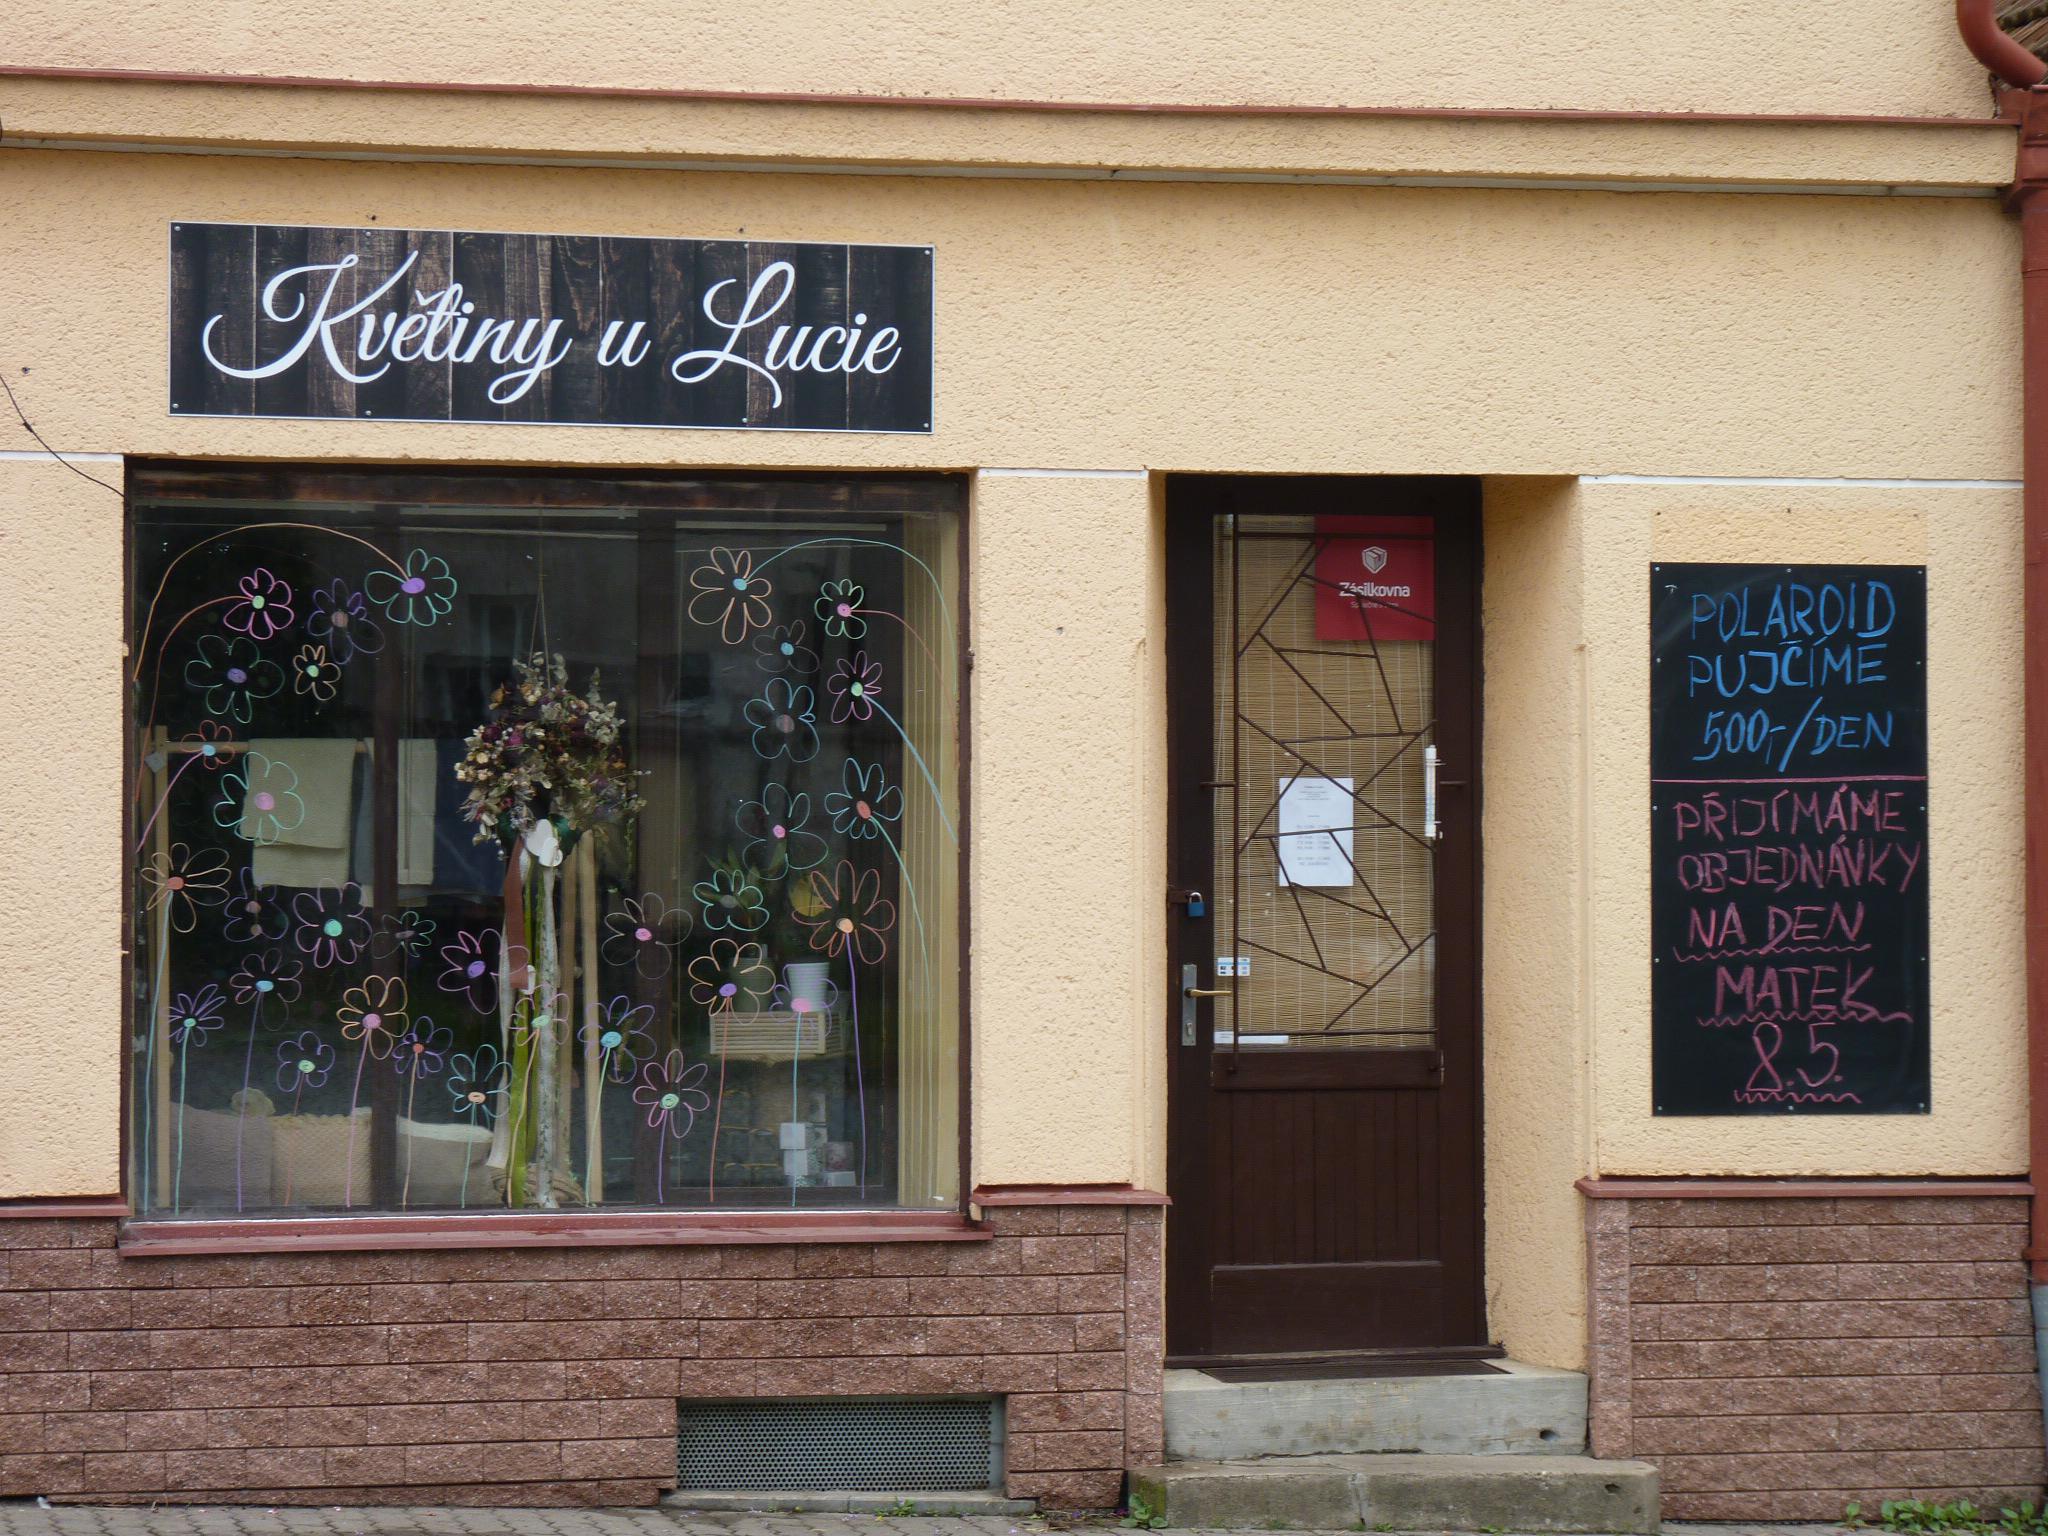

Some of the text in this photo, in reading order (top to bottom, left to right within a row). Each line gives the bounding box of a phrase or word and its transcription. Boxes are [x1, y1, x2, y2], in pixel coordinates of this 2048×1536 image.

[203, 250, 902, 409] Květiny u Lucie
[1339, 581, 1411, 598] Zásilkovna
[1691, 581, 1896, 643] POLAROID
[1678, 834, 1921, 894] OBJEDNÁVKY
[1688, 901, 1865, 953] NA DEN
[1714, 959, 1878, 1017] MATEK
